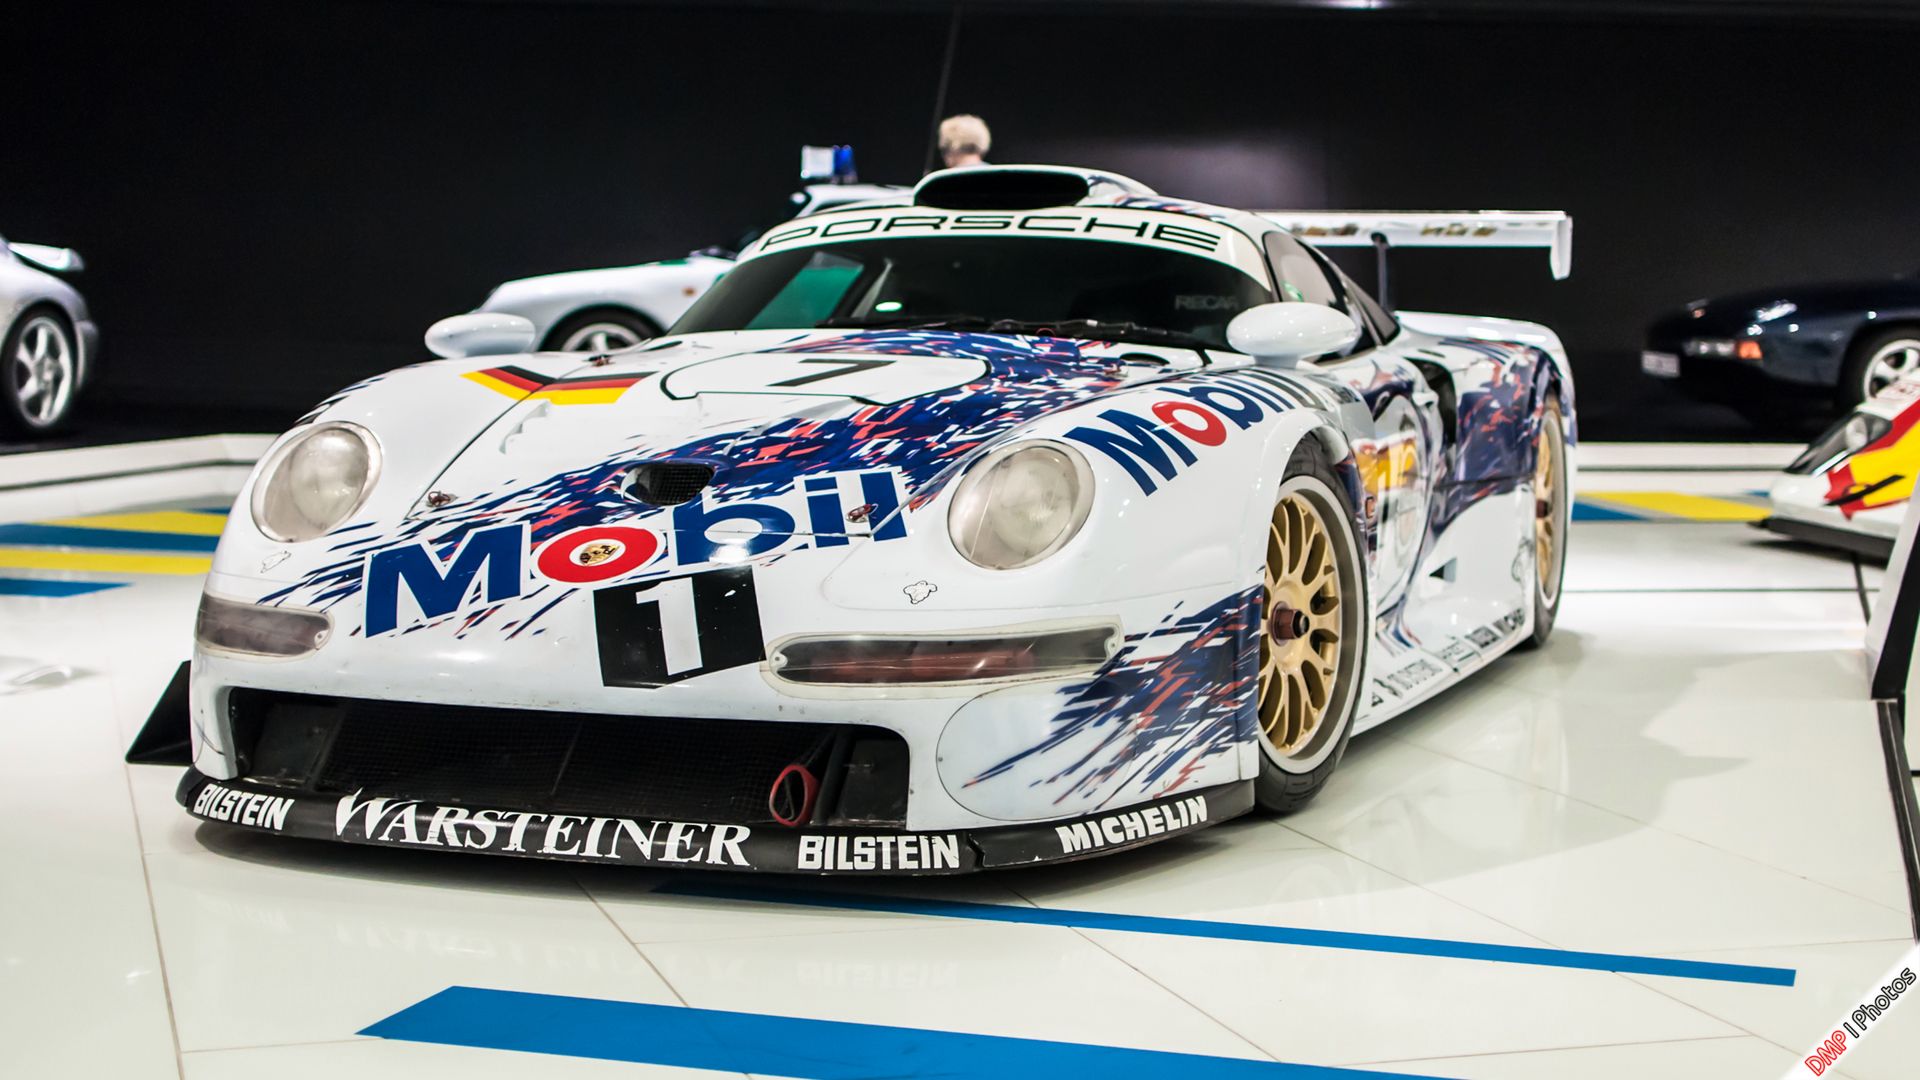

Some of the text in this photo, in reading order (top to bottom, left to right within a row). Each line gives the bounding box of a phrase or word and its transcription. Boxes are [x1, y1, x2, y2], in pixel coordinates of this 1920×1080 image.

[760, 215, 1221, 253] PORSCHE
[765, 358, 897, 387] 7
[1062, 373, 1297, 497] Mobil
[365, 471, 907, 638] Mobil
[635, 576, 704, 677] 1
[195, 784, 295, 831] BILSTEIN
[335, 787, 752, 867] WARSTEINER
[1056, 796, 1207, 854] MICHELIN
[798, 834, 959, 870] BILSTEIN
